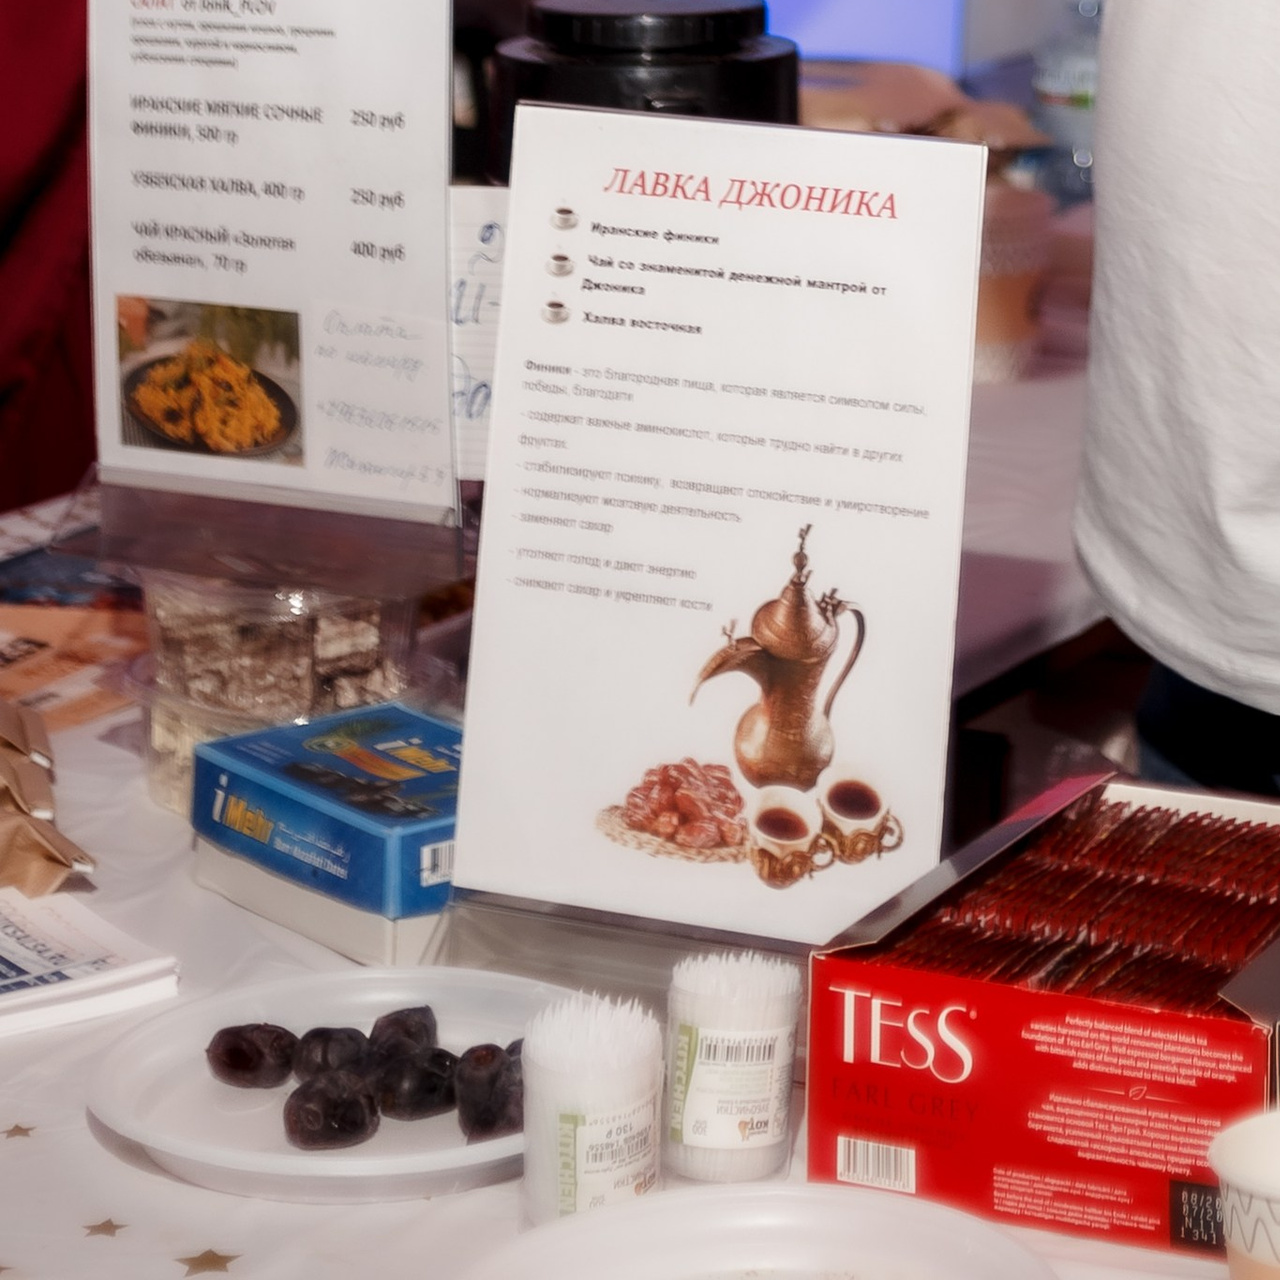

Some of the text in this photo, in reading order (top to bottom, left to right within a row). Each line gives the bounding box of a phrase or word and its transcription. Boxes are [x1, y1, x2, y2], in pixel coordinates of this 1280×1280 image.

[603, 167, 899, 220] ЛАВКА ДЖОНИКА
[591, 221, 719, 246] Иранские финики
[581, 277, 645, 296] Джоника
[588, 254, 887, 296] Чай со знаменитой денежной мантрой от
[583, 310, 703, 335] Халва восточная
[829, 985, 973, 1084] TESS
[1030, 1021, 1243, 1062] varieties harvested on the world renowned plantations becomes the
[1065, 1015, 1207, 1046] Perfectly balanced blend of selected black tea
[1021, 1029, 1056, 1044] foundation
[1058, 1035, 1064, 1045] of
[1067, 1036, 1080, 1047] Tess
[1082, 1038, 1094, 1049] Earl
[1095, 1040, 1111, 1053] Grey.
[1112, 1043, 1126, 1054] Well
[1128, 1047, 1160, 1059] expressed
[1160, 1050, 1192, 1064] bergamot
[1219, 1060, 1252, 1074] enhanced
[1035, 1042, 1049, 1053] with
[1050, 1044, 1076, 1057] bitterish
[1078, 1049, 1095, 1060] notes
[1096, 1051, 1103, 1061] of
[1104, 1052, 1118, 1064] lime
[1119, 1056, 1136, 1066] peels
[1136, 1058, 1149, 1068] and
[1150, 1061, 1178, 1073] sweetish
[1180, 1065, 1202, 1076] sparkle
[1204, 1068, 1210, 1078] of
[1072, 1058, 1197, 1086] adds distinctive sound to this tea blend.
[832, 1077, 895, 1109] EARL
[907, 1091, 980, 1124] GREY
